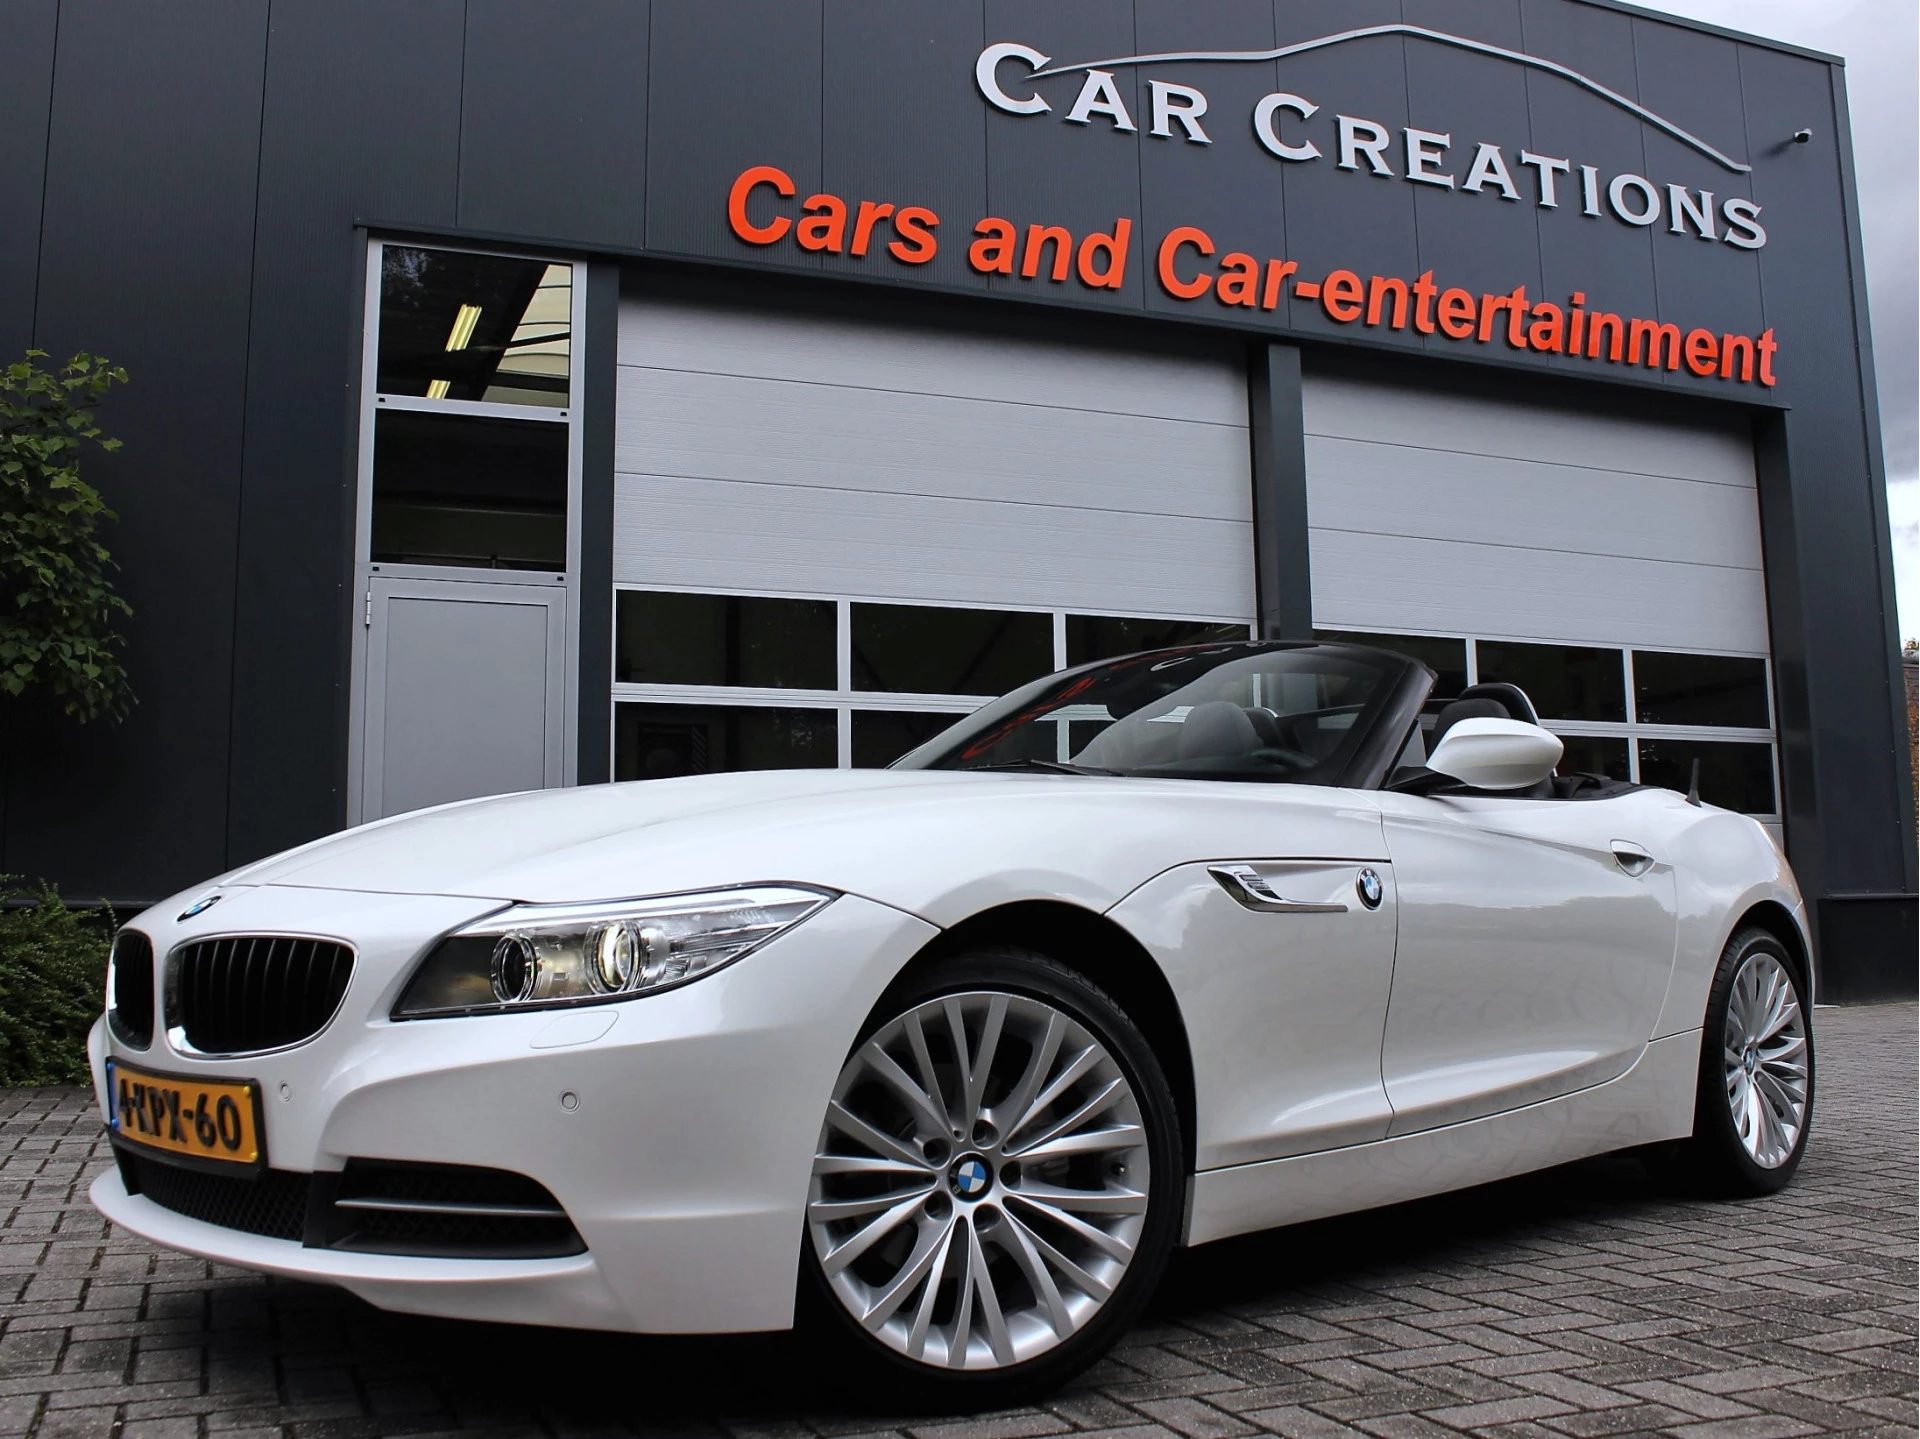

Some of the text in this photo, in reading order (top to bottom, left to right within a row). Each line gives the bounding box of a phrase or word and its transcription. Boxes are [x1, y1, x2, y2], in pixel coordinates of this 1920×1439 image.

[975, 42, 1768, 250] CAR CREATIONS
[728, 165, 1777, 386] Cars and Car-entertainment
